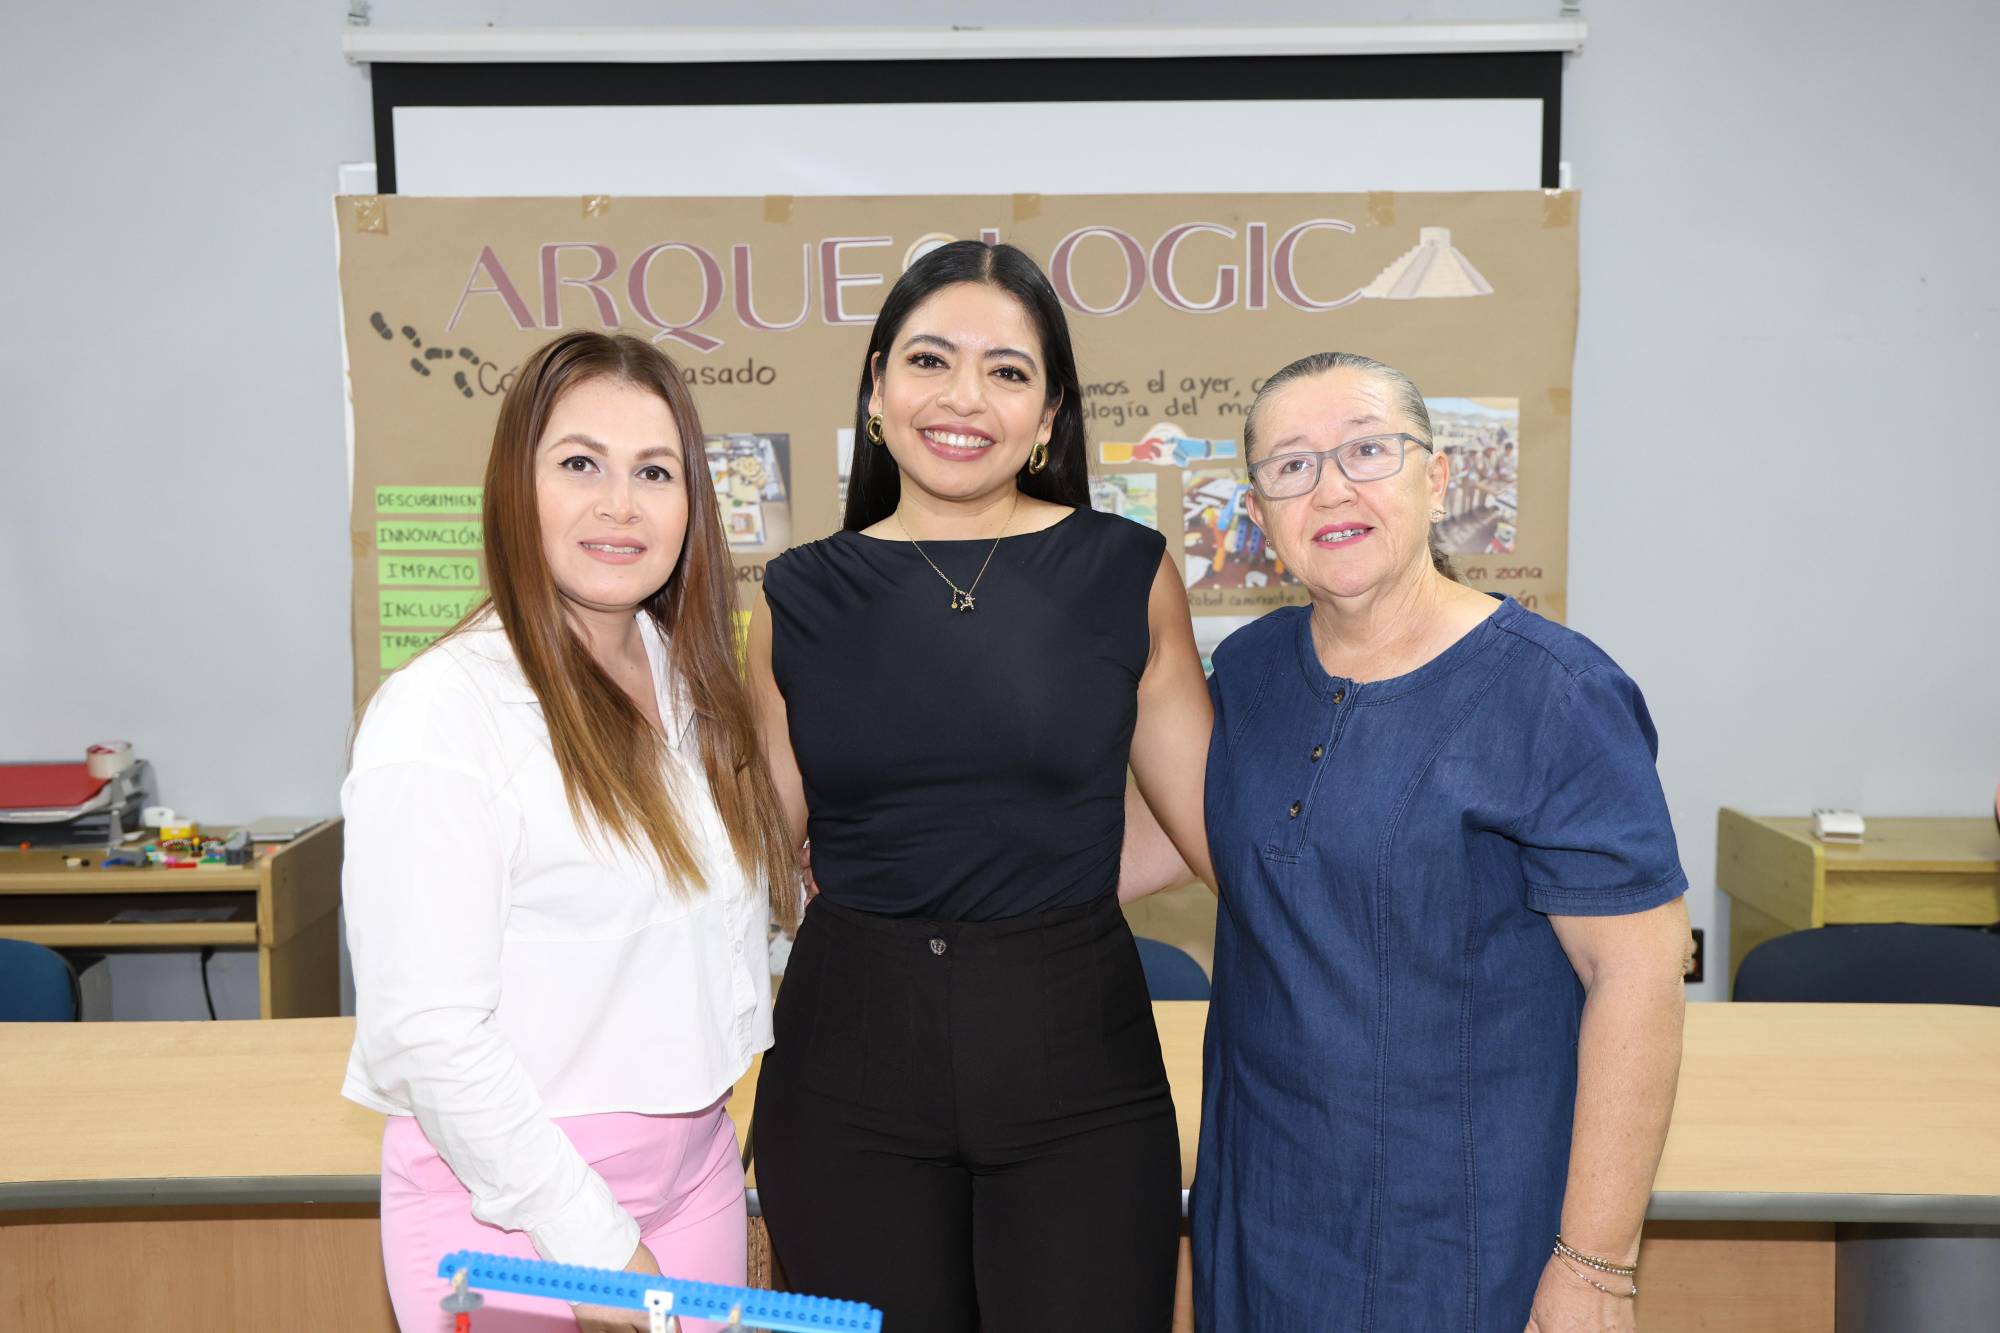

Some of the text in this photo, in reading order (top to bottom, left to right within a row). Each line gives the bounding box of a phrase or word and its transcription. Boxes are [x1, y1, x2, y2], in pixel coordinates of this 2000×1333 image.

[444, 217, 1364, 354] ARQUEOGIC
[680, 357, 777, 386] asado
[1146, 369, 1166, 394] el
[1180, 376, 1242, 398] ayer,
[1164, 397, 1199, 417] del
[386, 562, 475, 580] IMPACTO
